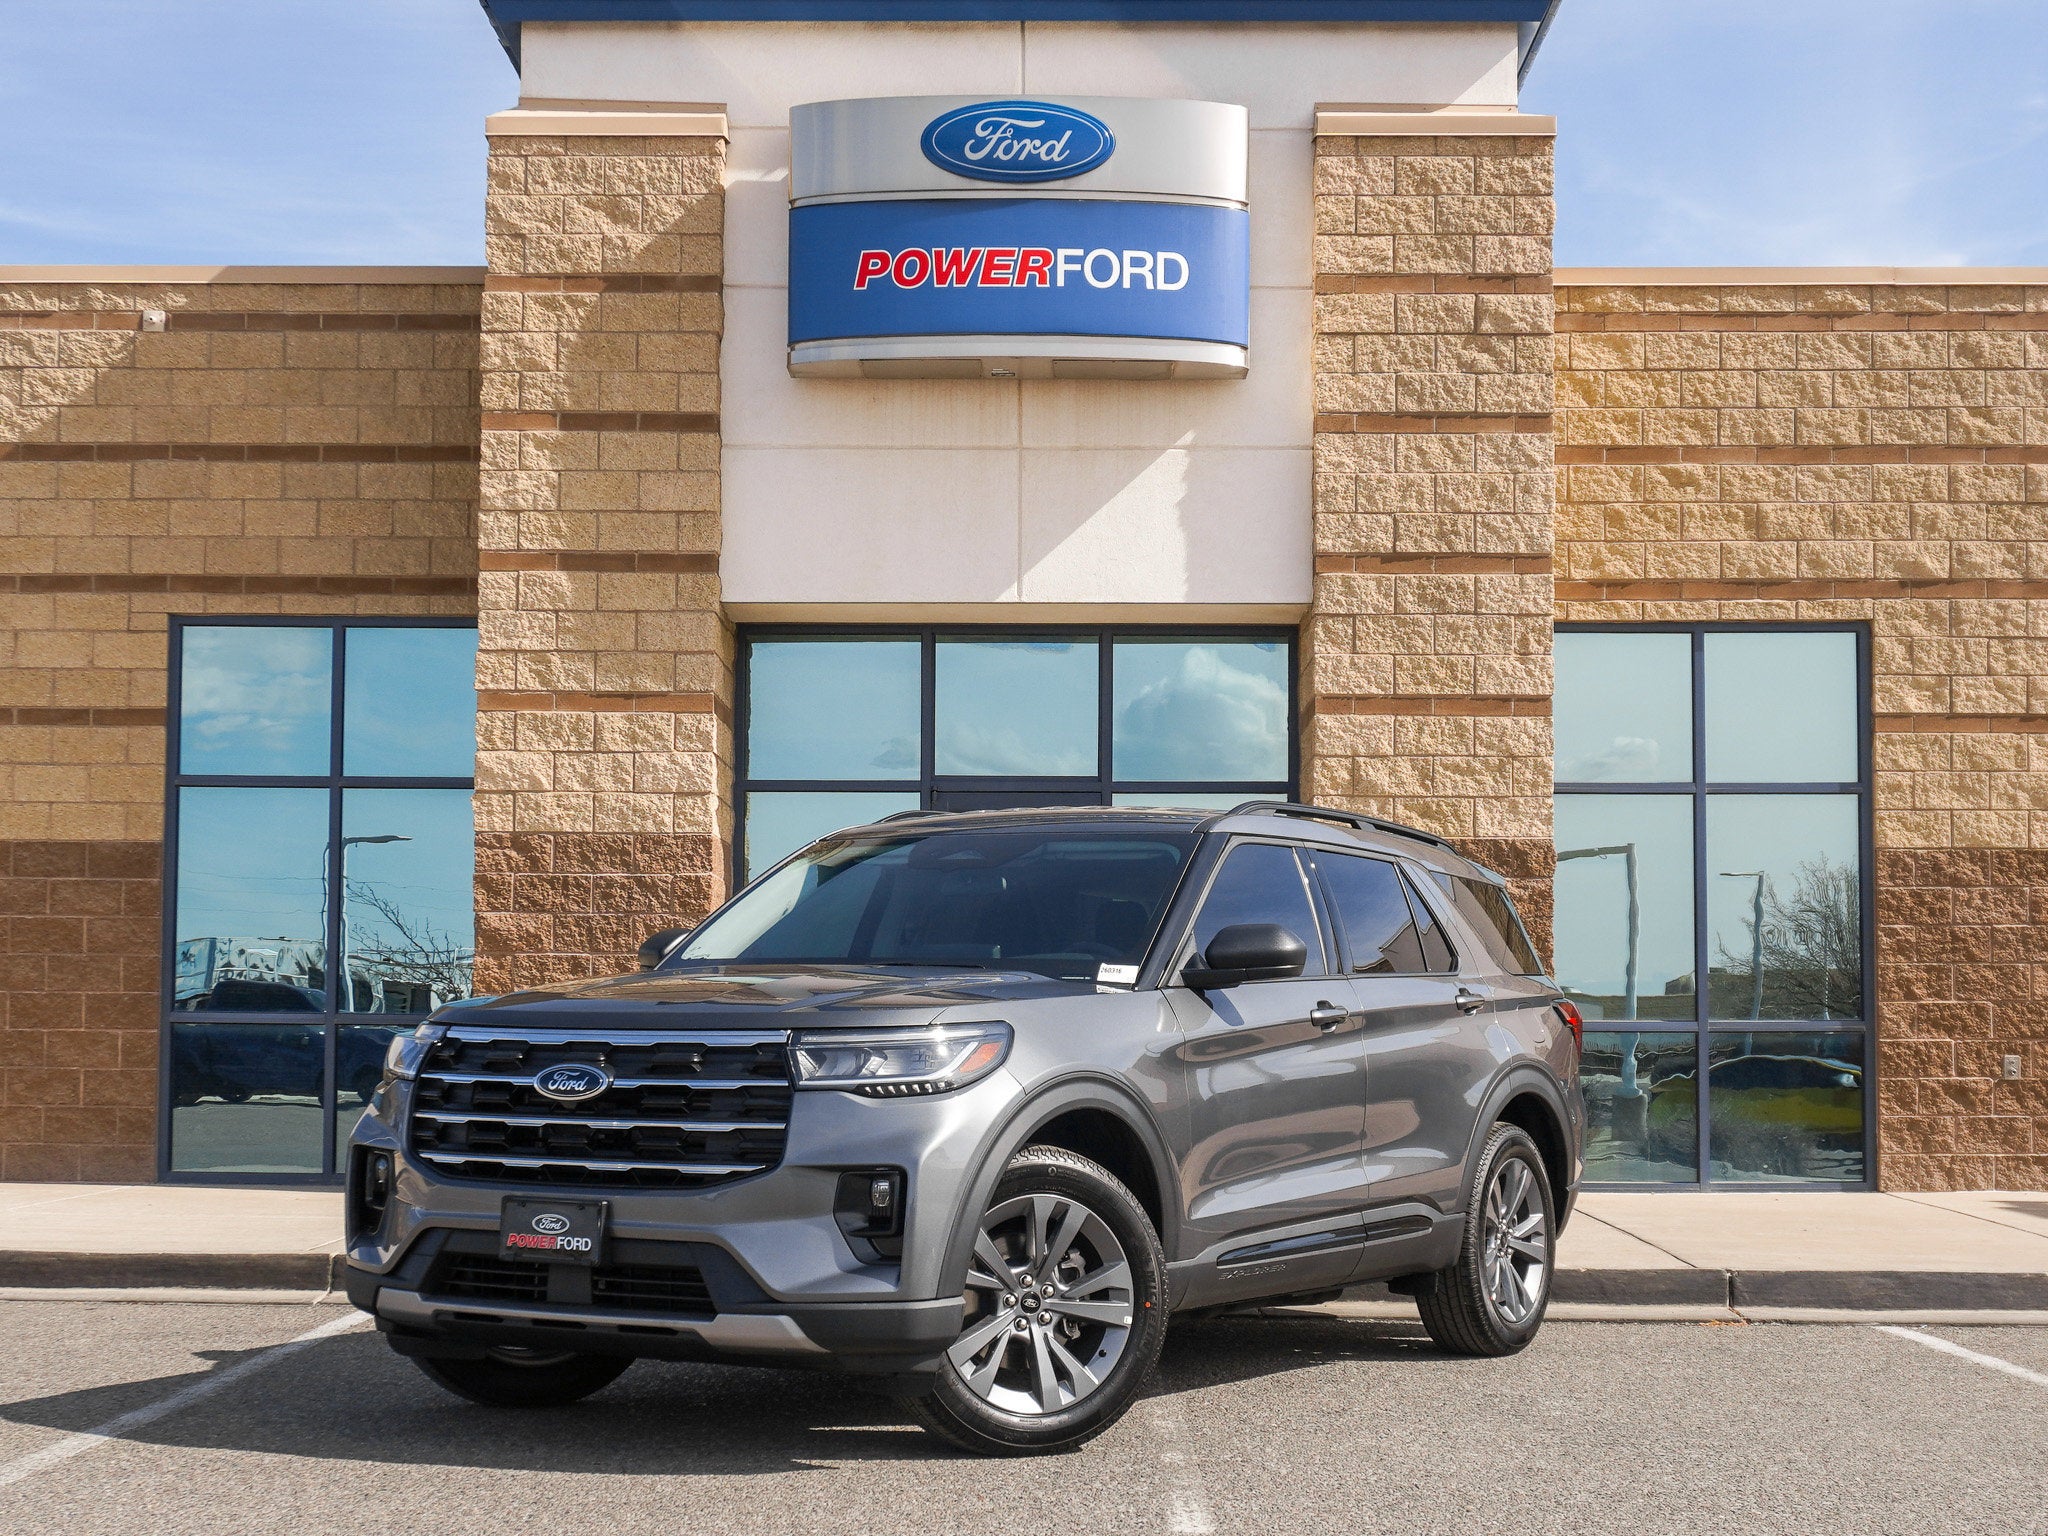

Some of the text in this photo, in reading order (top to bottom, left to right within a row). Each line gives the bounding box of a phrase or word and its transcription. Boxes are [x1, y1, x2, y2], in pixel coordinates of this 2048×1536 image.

[964, 117, 1072, 162] Ford
[852, 247, 1190, 291] POWERFORD
[548, 1070, 589, 1091] Ford
[539, 1217, 563, 1229] Ford
[507, 1233, 592, 1251] POWERFORD
